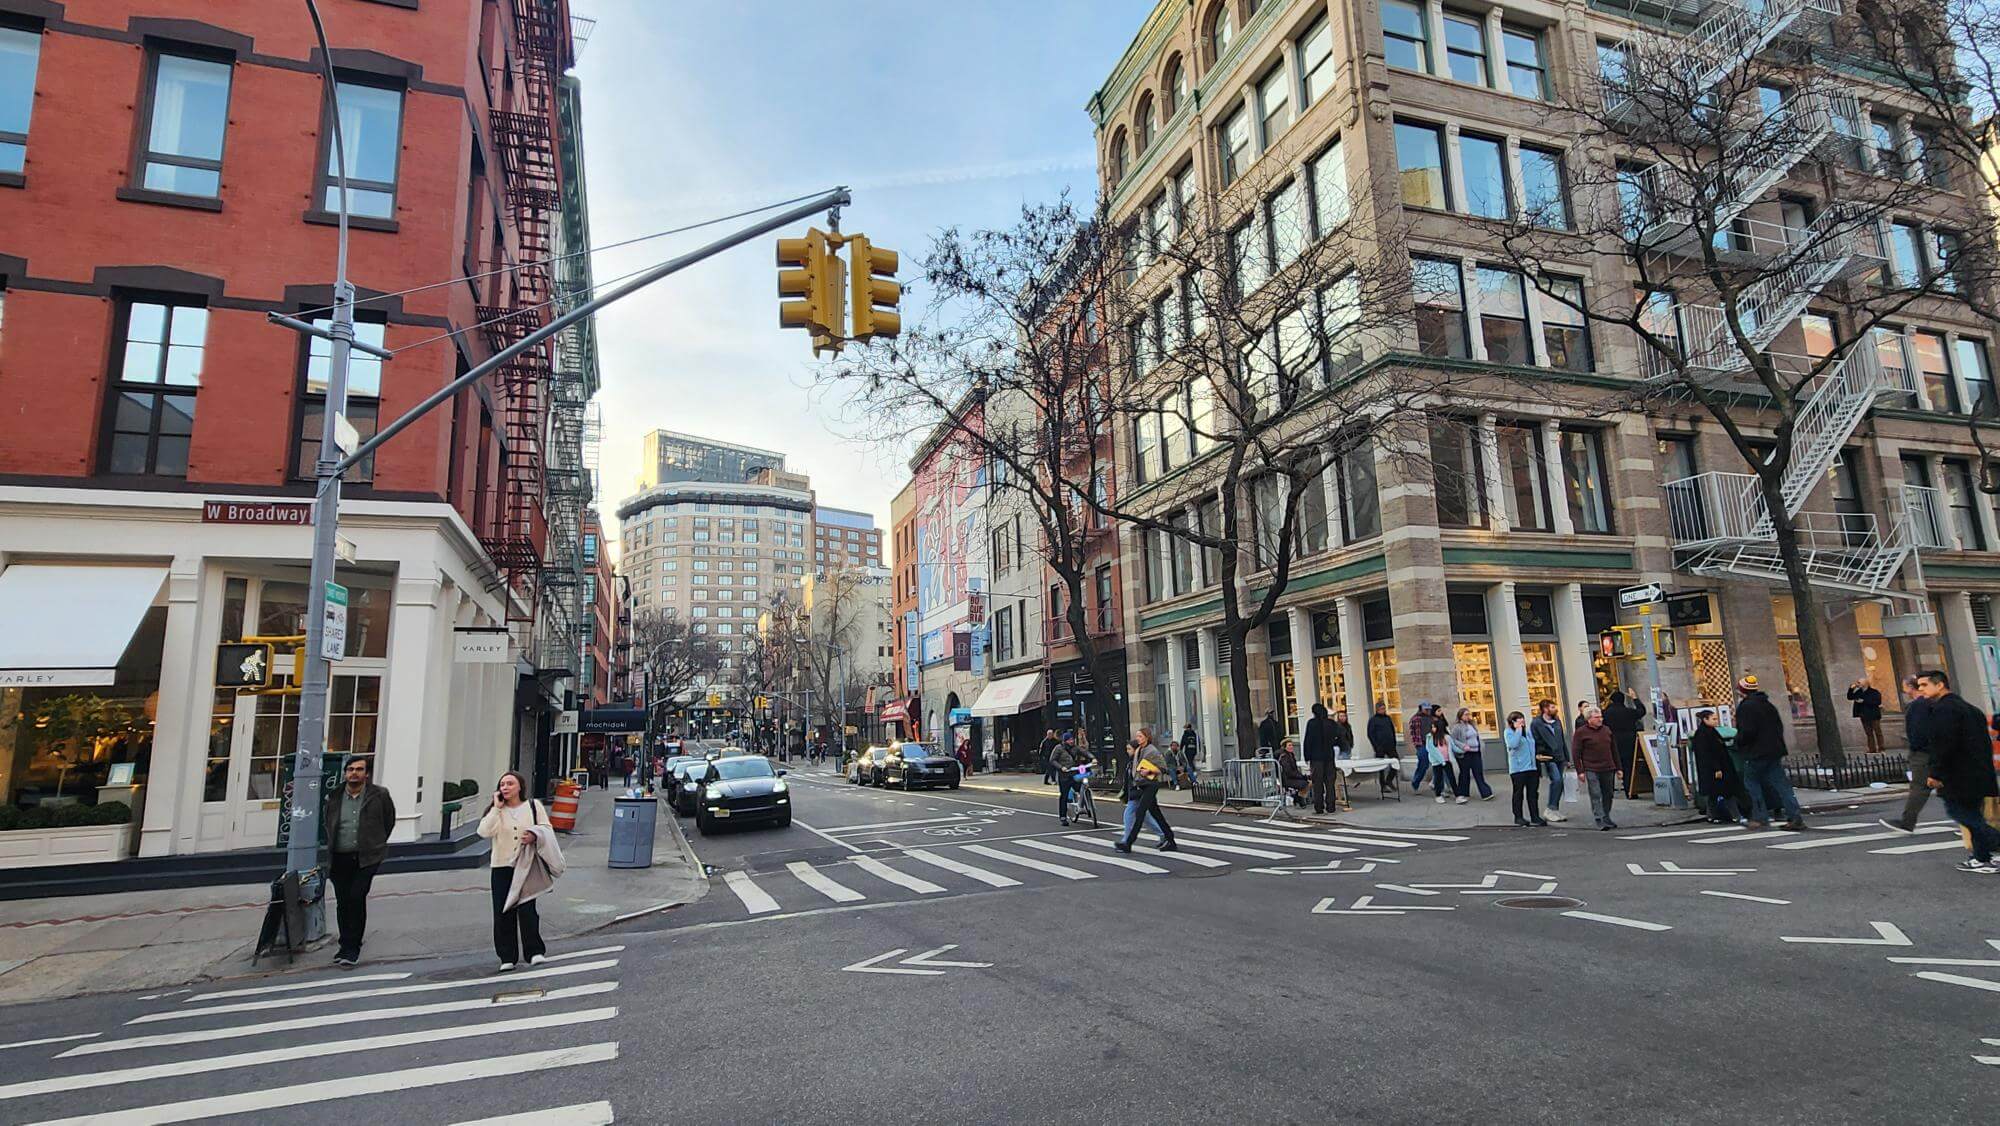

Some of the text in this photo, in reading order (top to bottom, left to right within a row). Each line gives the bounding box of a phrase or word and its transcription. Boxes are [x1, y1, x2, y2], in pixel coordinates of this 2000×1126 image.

[207, 504, 308, 524] W Broadway
[970, 596, 980, 604] BO
[1623, 592, 1637, 601] ONE
[970, 605, 983, 613] QUE
[970, 613, 983, 623] RIA
[325, 626, 344, 641] SHARED
[326, 642, 340, 655] LANE
[585, 721, 627, 729] mochidoki
